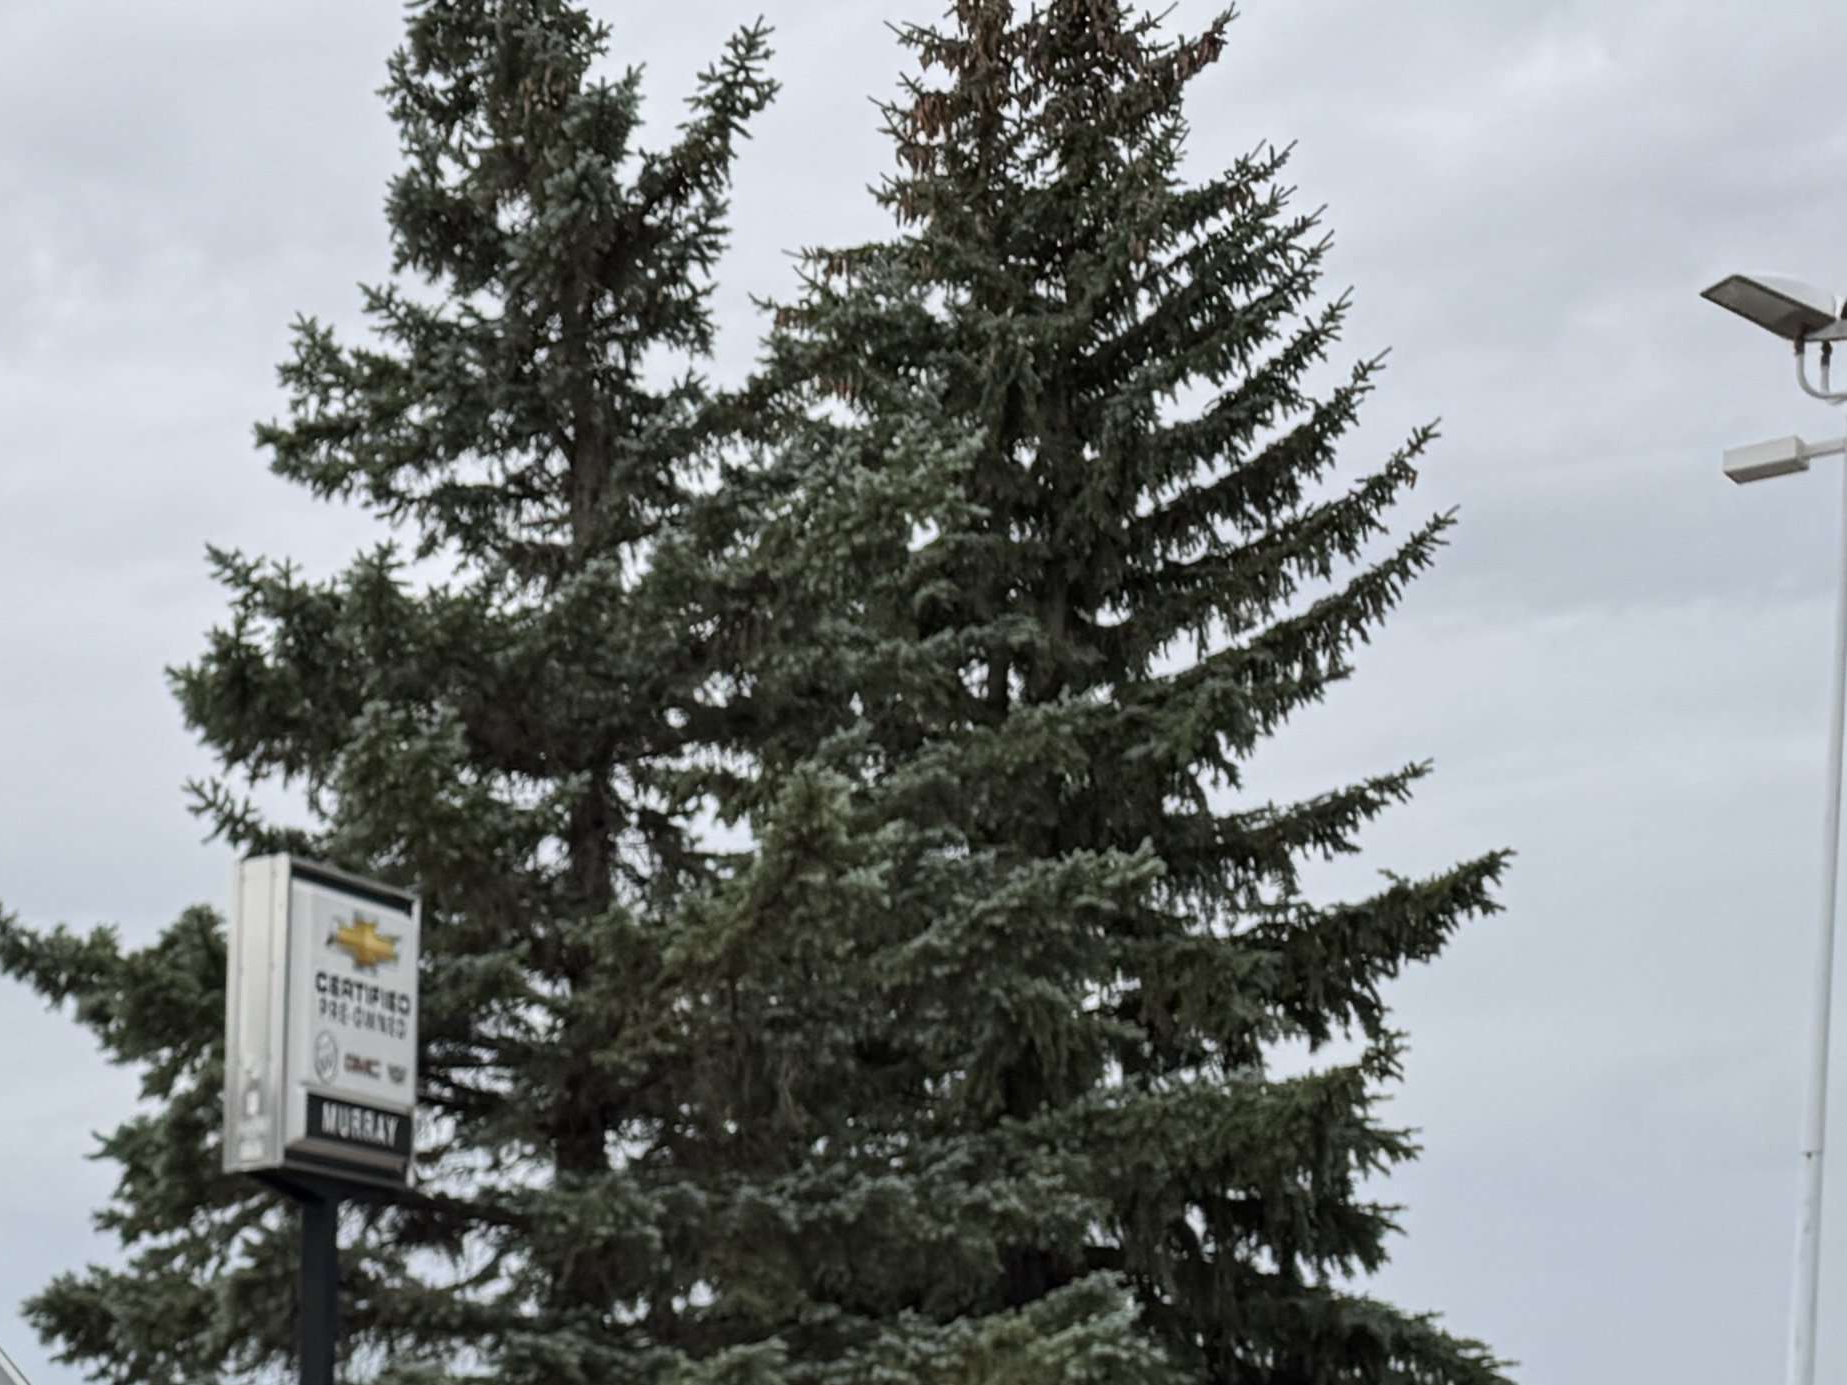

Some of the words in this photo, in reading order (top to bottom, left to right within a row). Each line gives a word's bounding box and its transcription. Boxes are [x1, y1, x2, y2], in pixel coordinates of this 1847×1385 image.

[316, 972, 410, 1016] CERTIFIED
[319, 998, 406, 1040] PRE-OWNED
[321, 1102, 399, 1147] MURRAY
